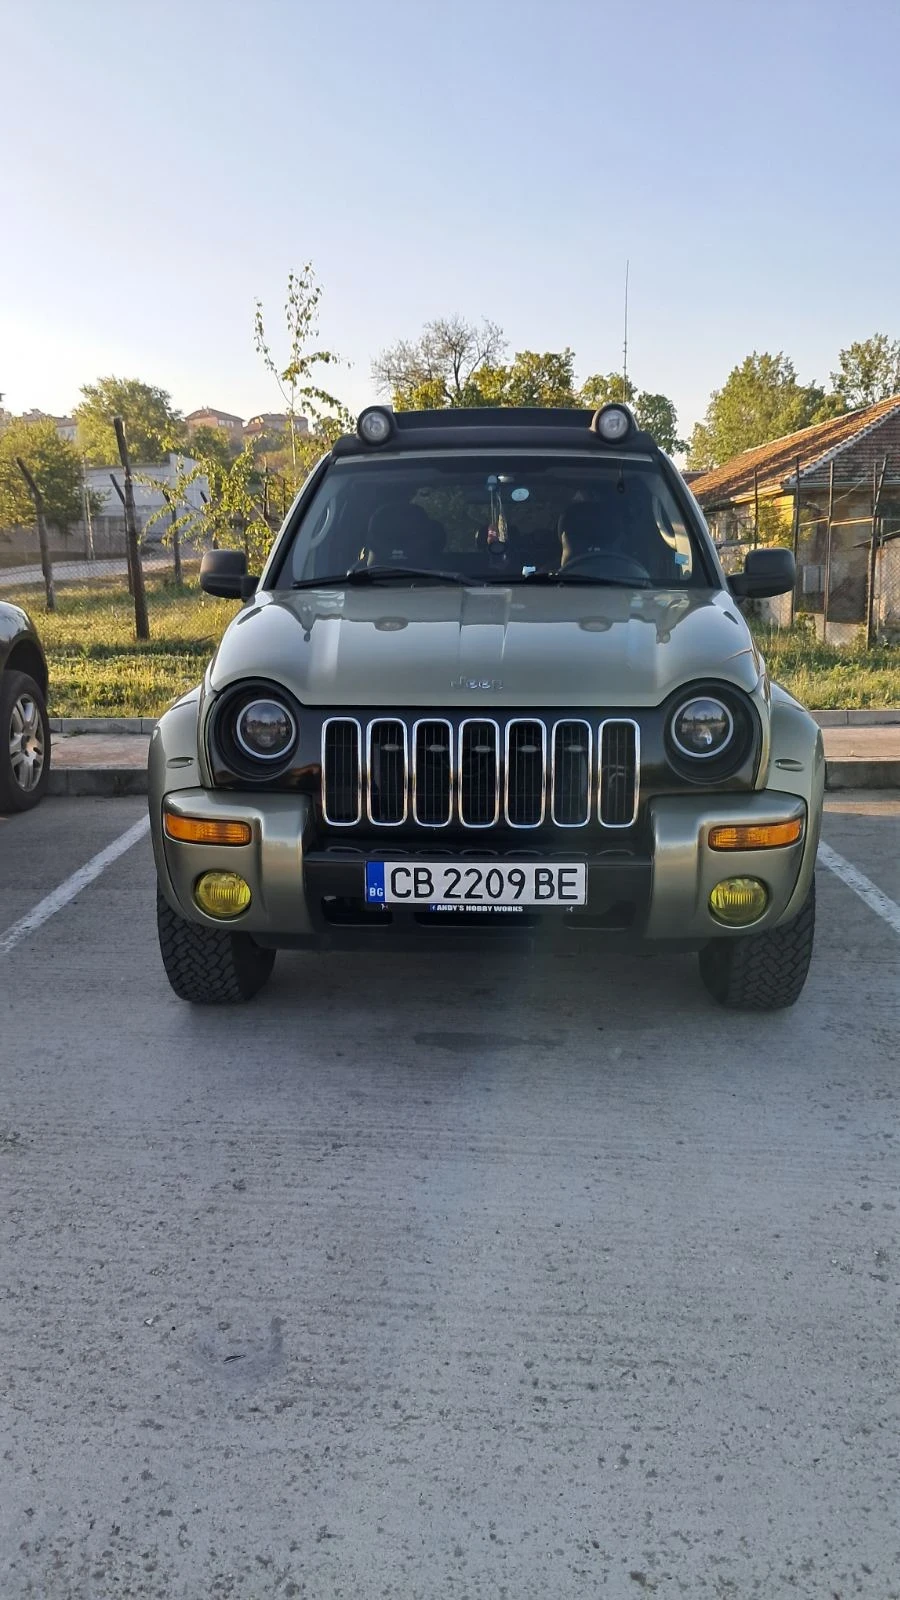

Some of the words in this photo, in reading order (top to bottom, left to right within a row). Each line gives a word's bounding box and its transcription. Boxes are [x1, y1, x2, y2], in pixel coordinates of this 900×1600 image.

[369, 887, 384, 897] BG
[390, 867, 435, 899] CB
[443, 868, 526, 899] 2209
[534, 868, 578, 900] BE
